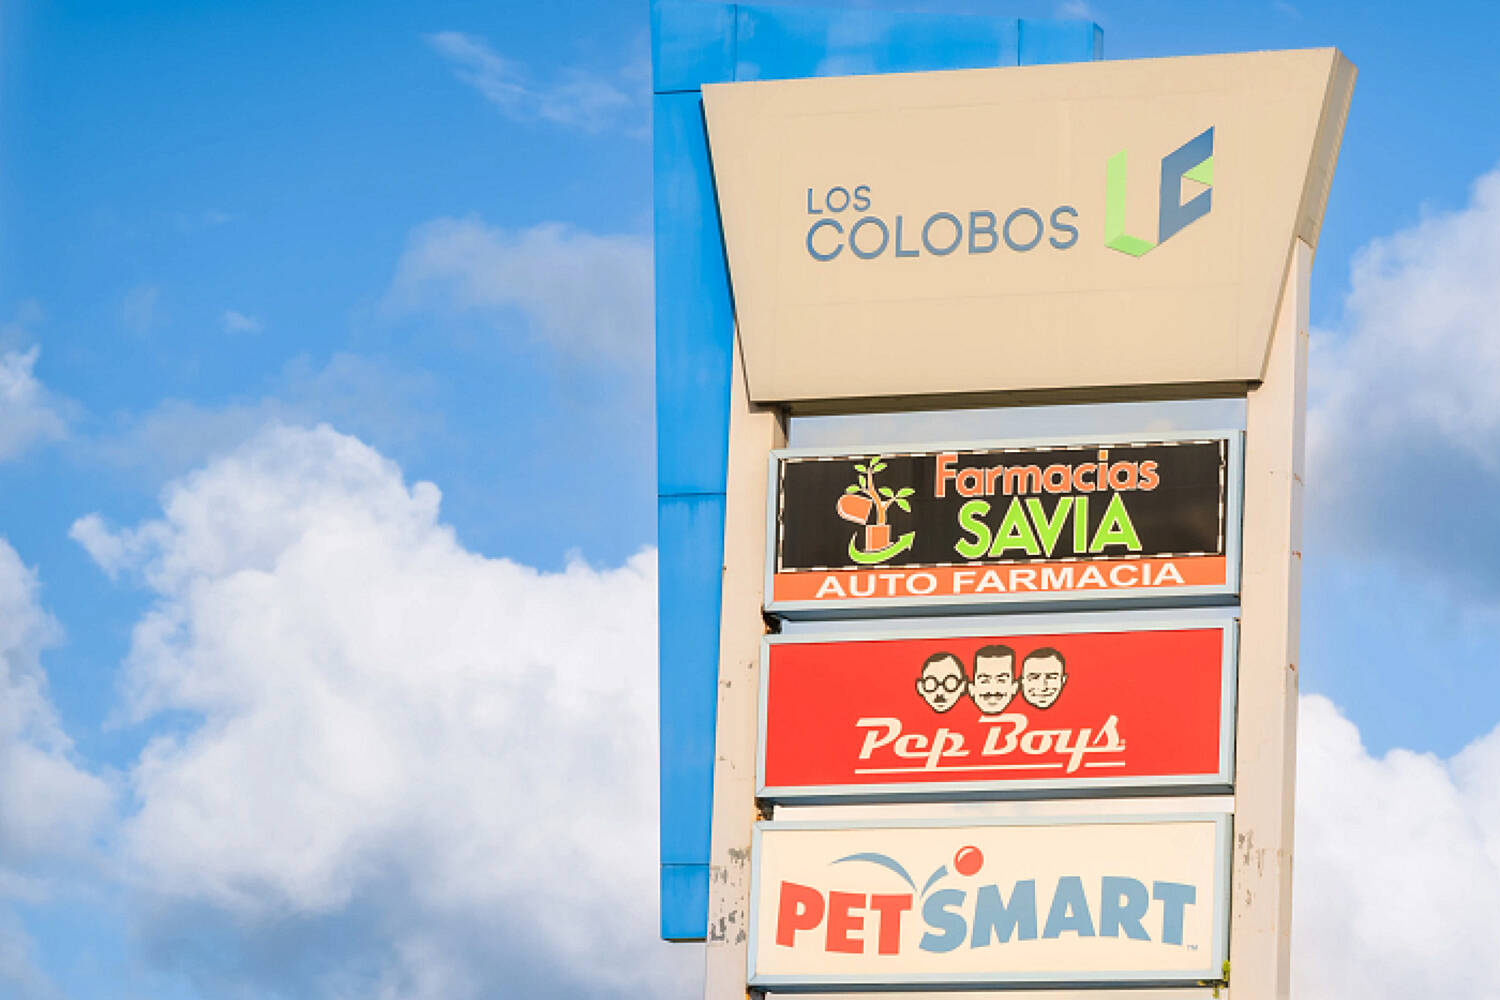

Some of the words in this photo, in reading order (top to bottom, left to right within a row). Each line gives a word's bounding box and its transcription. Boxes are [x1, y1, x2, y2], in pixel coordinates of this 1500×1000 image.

[808, 186, 871, 214] LOS
[806, 205, 1079, 262] COLOBOS
[935, 450, 1159, 497] Farmacias
[955, 493, 1141, 558] SAVIA
[816, 570, 938, 599] AUTO
[953, 562, 1185, 594] FARMACIA
[855, 718, 970, 770] Pep
[979, 714, 1126, 773] Boys
[775, 875, 1197, 955] PETSMART
